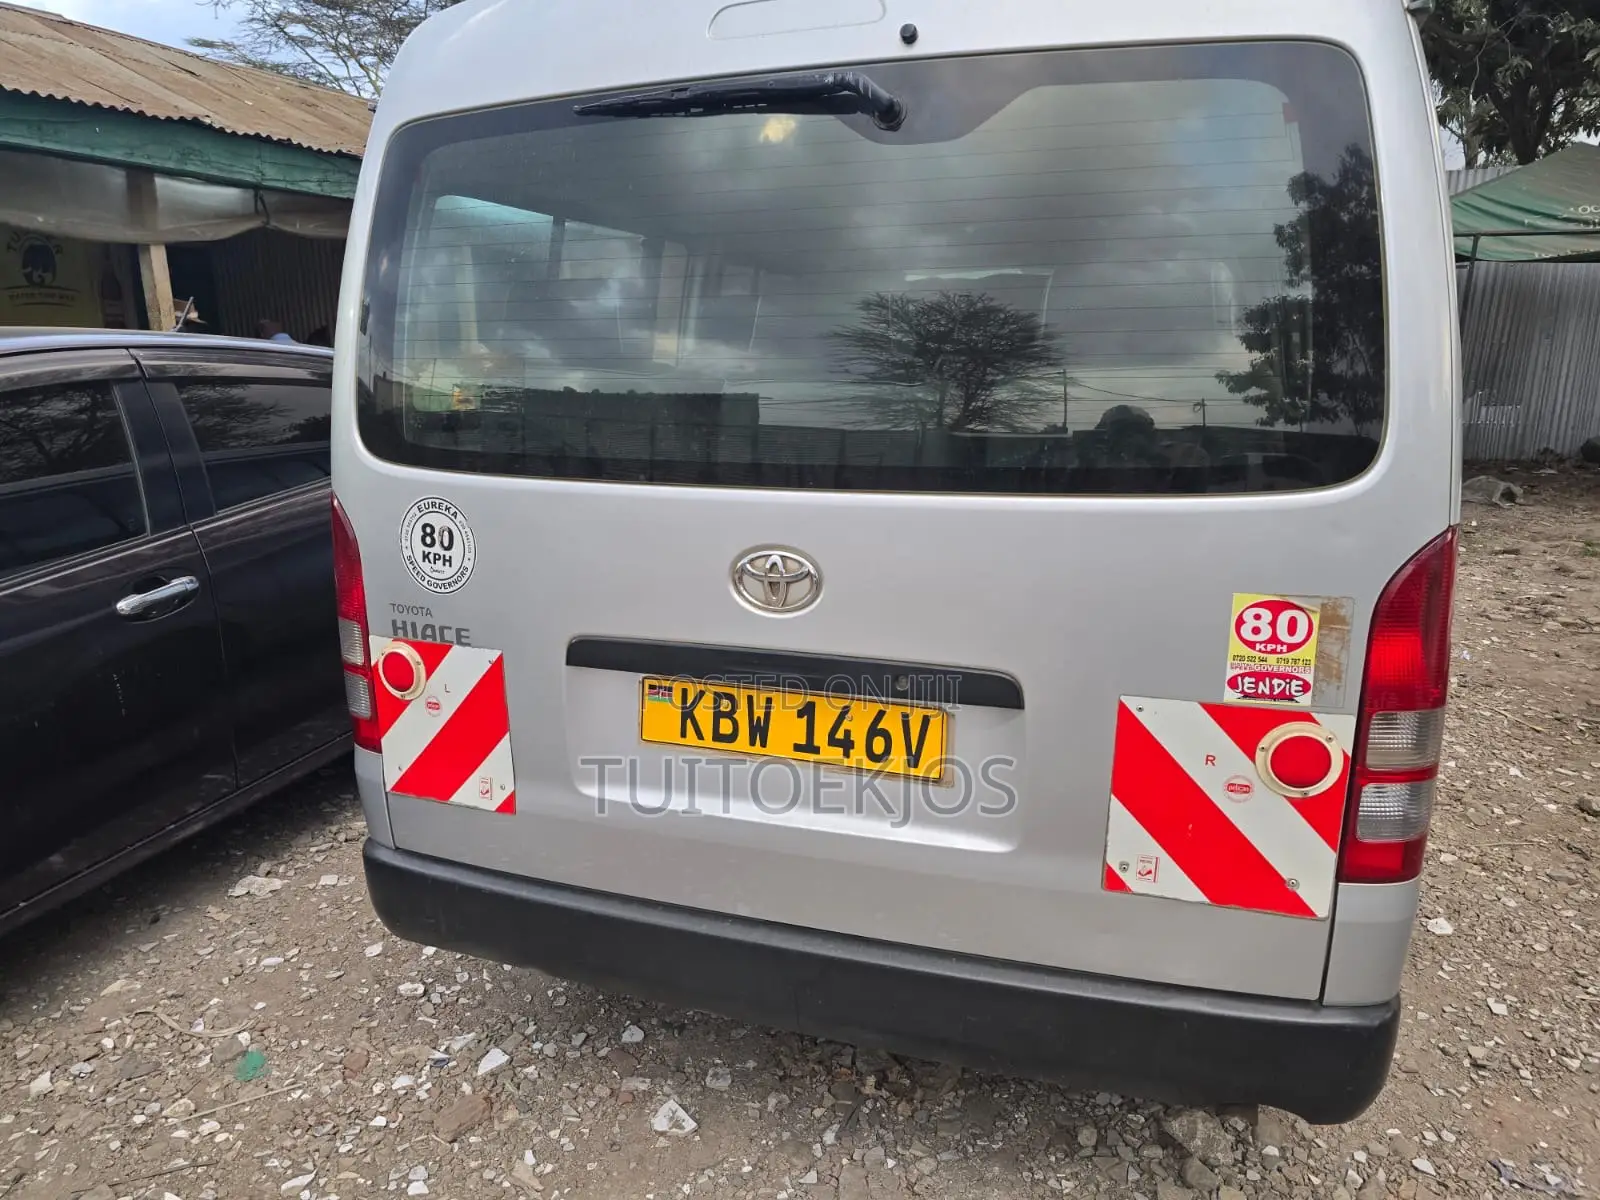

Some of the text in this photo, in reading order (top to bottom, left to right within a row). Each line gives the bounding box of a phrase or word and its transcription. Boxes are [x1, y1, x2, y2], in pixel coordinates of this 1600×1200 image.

[416, 501, 459, 520] EUREKA
[420, 522, 455, 552] 80
[406, 555, 427, 582] SPEED
[421, 550, 453, 568] KPH
[426, 565, 470, 590] GOVERNORS
[390, 603, 433, 617] TOYOTA
[391, 619, 472, 646] HIACE
[1239, 607, 1310, 644] 80
[1255, 643, 1288, 653] KPH
[1254, 664, 1312, 674] GOVERNORS
[679, 686, 931, 769] KBW 146V
[1205, 754, 1216, 767] R
